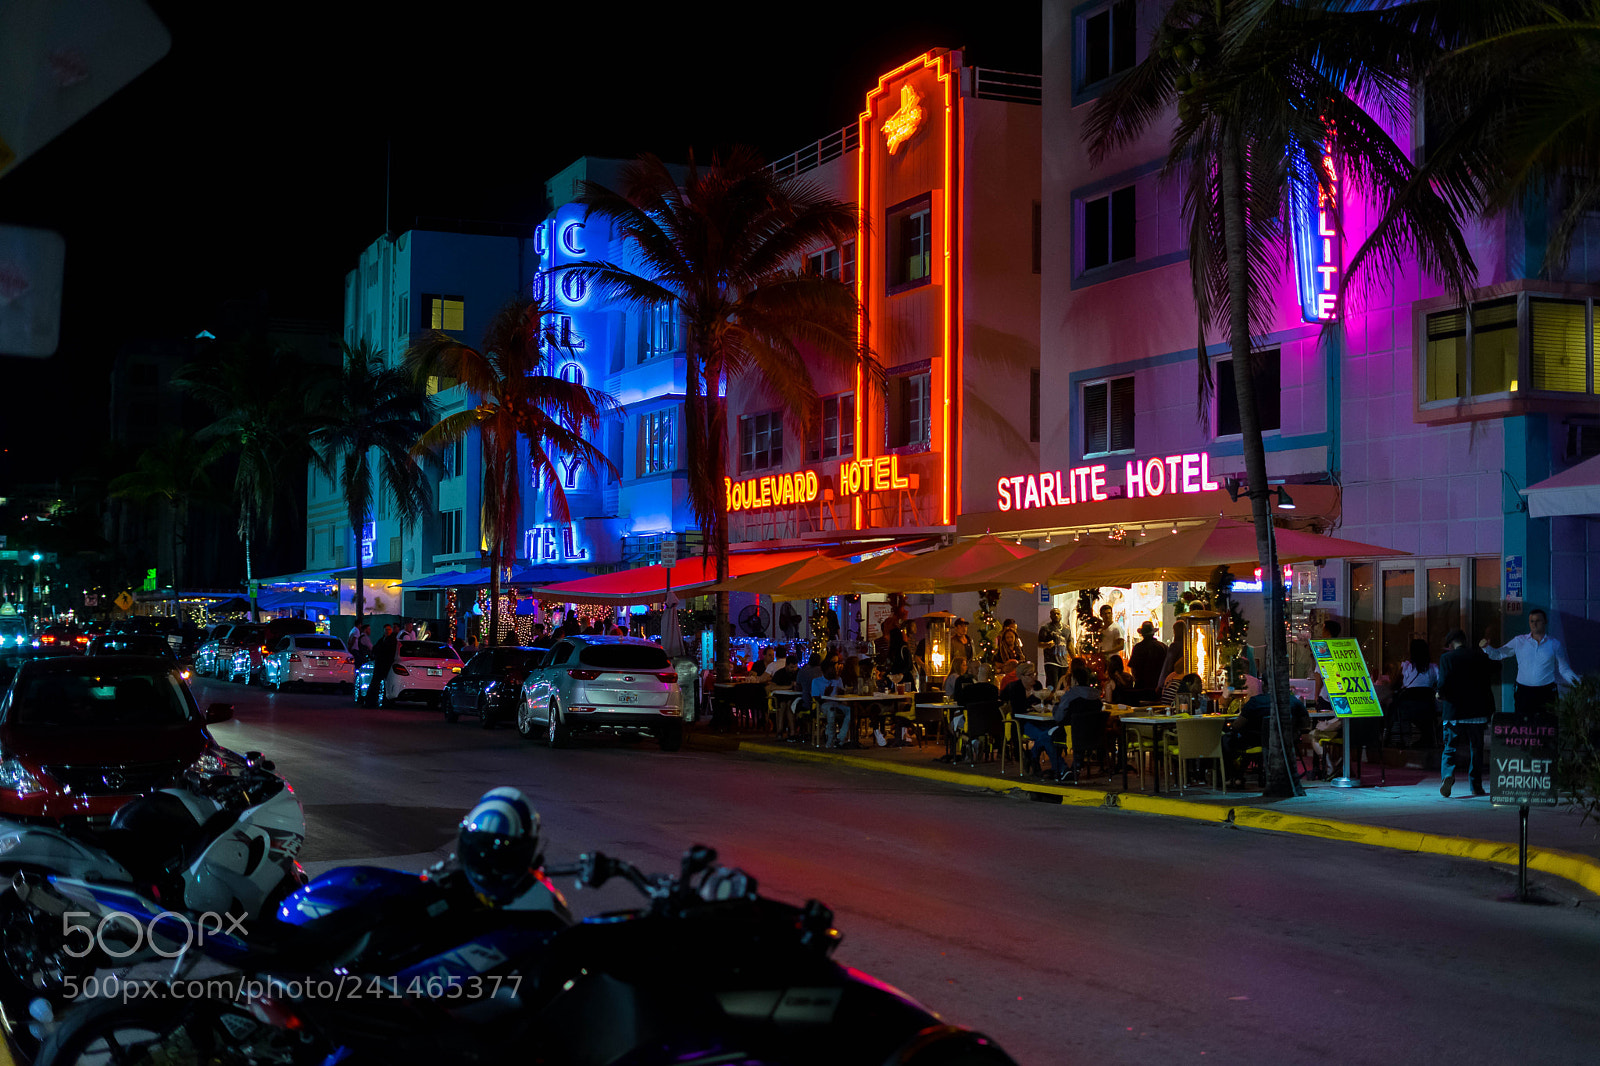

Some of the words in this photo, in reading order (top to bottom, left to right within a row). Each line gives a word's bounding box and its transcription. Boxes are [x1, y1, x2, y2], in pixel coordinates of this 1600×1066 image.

[1318, 98, 1337, 319] ARLITE
[840, 455, 909, 497] HOTEL
[997, 464, 1108, 512] STARLITE
[1126, 452, 1219, 499] HOTEL
[524, 528, 586, 560] TEL
[1332, 650, 1358, 659] HAPPY
[1338, 662, 1364, 671] HOUR
[1342, 676, 1372, 693] 2X1
[1348, 696, 1375, 705] DRINKS
[1494, 725, 1555, 736] STARLITE
[1505, 737, 1544, 746] HOTEL
[1496, 758, 1553, 773] VALET
[1497, 775, 1551, 789] PARKING
